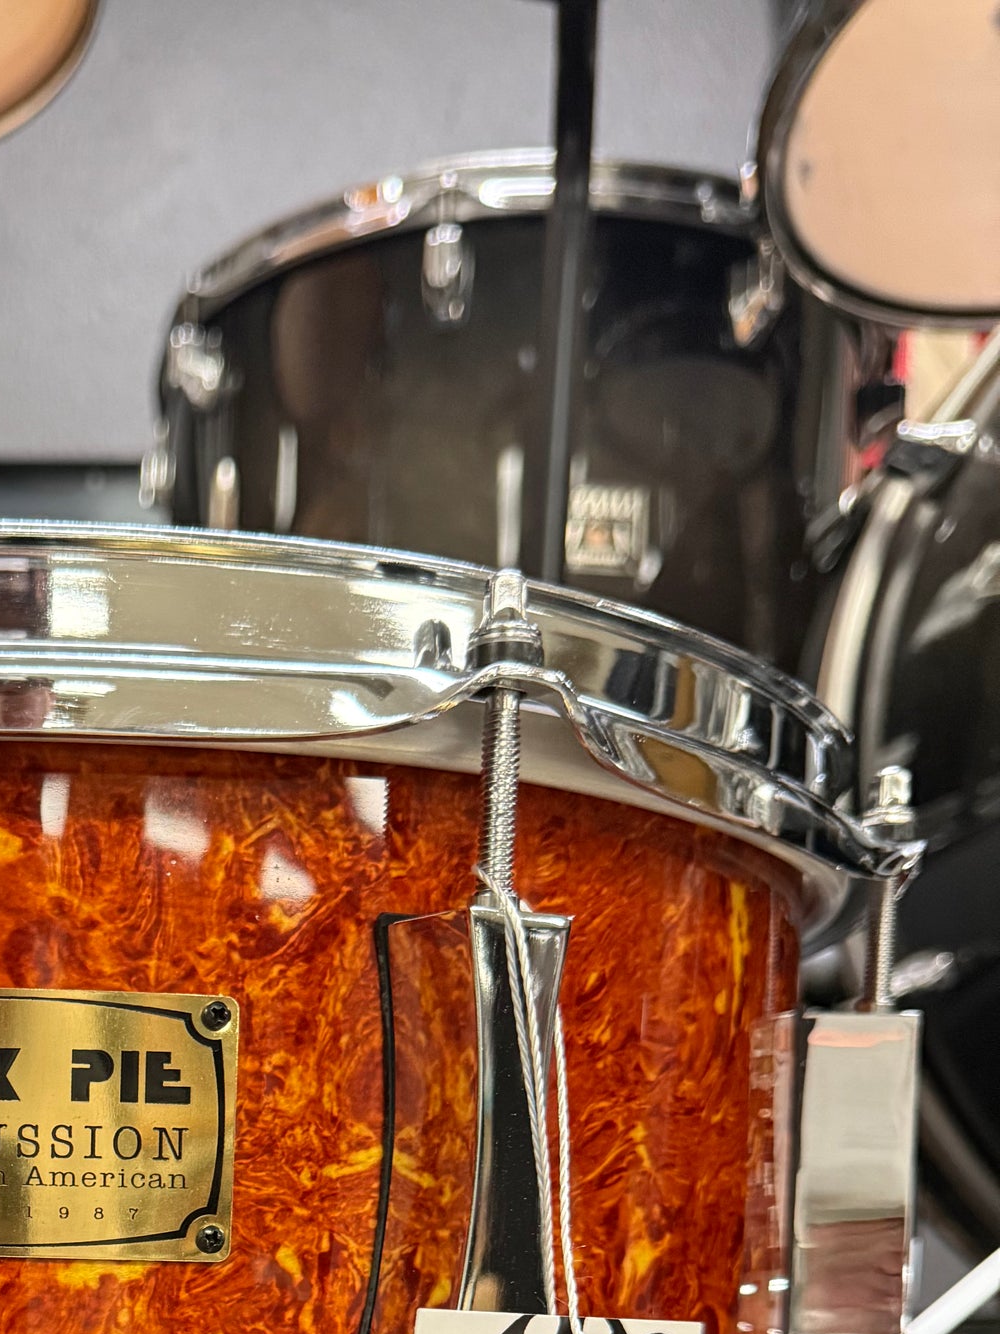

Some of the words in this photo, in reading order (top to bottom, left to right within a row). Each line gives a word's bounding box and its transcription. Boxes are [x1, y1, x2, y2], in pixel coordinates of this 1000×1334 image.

[70, 1049, 191, 1105] PIE
[21, 1167, 189, 1190] American
[25, 1206, 139, 1220] 1987
